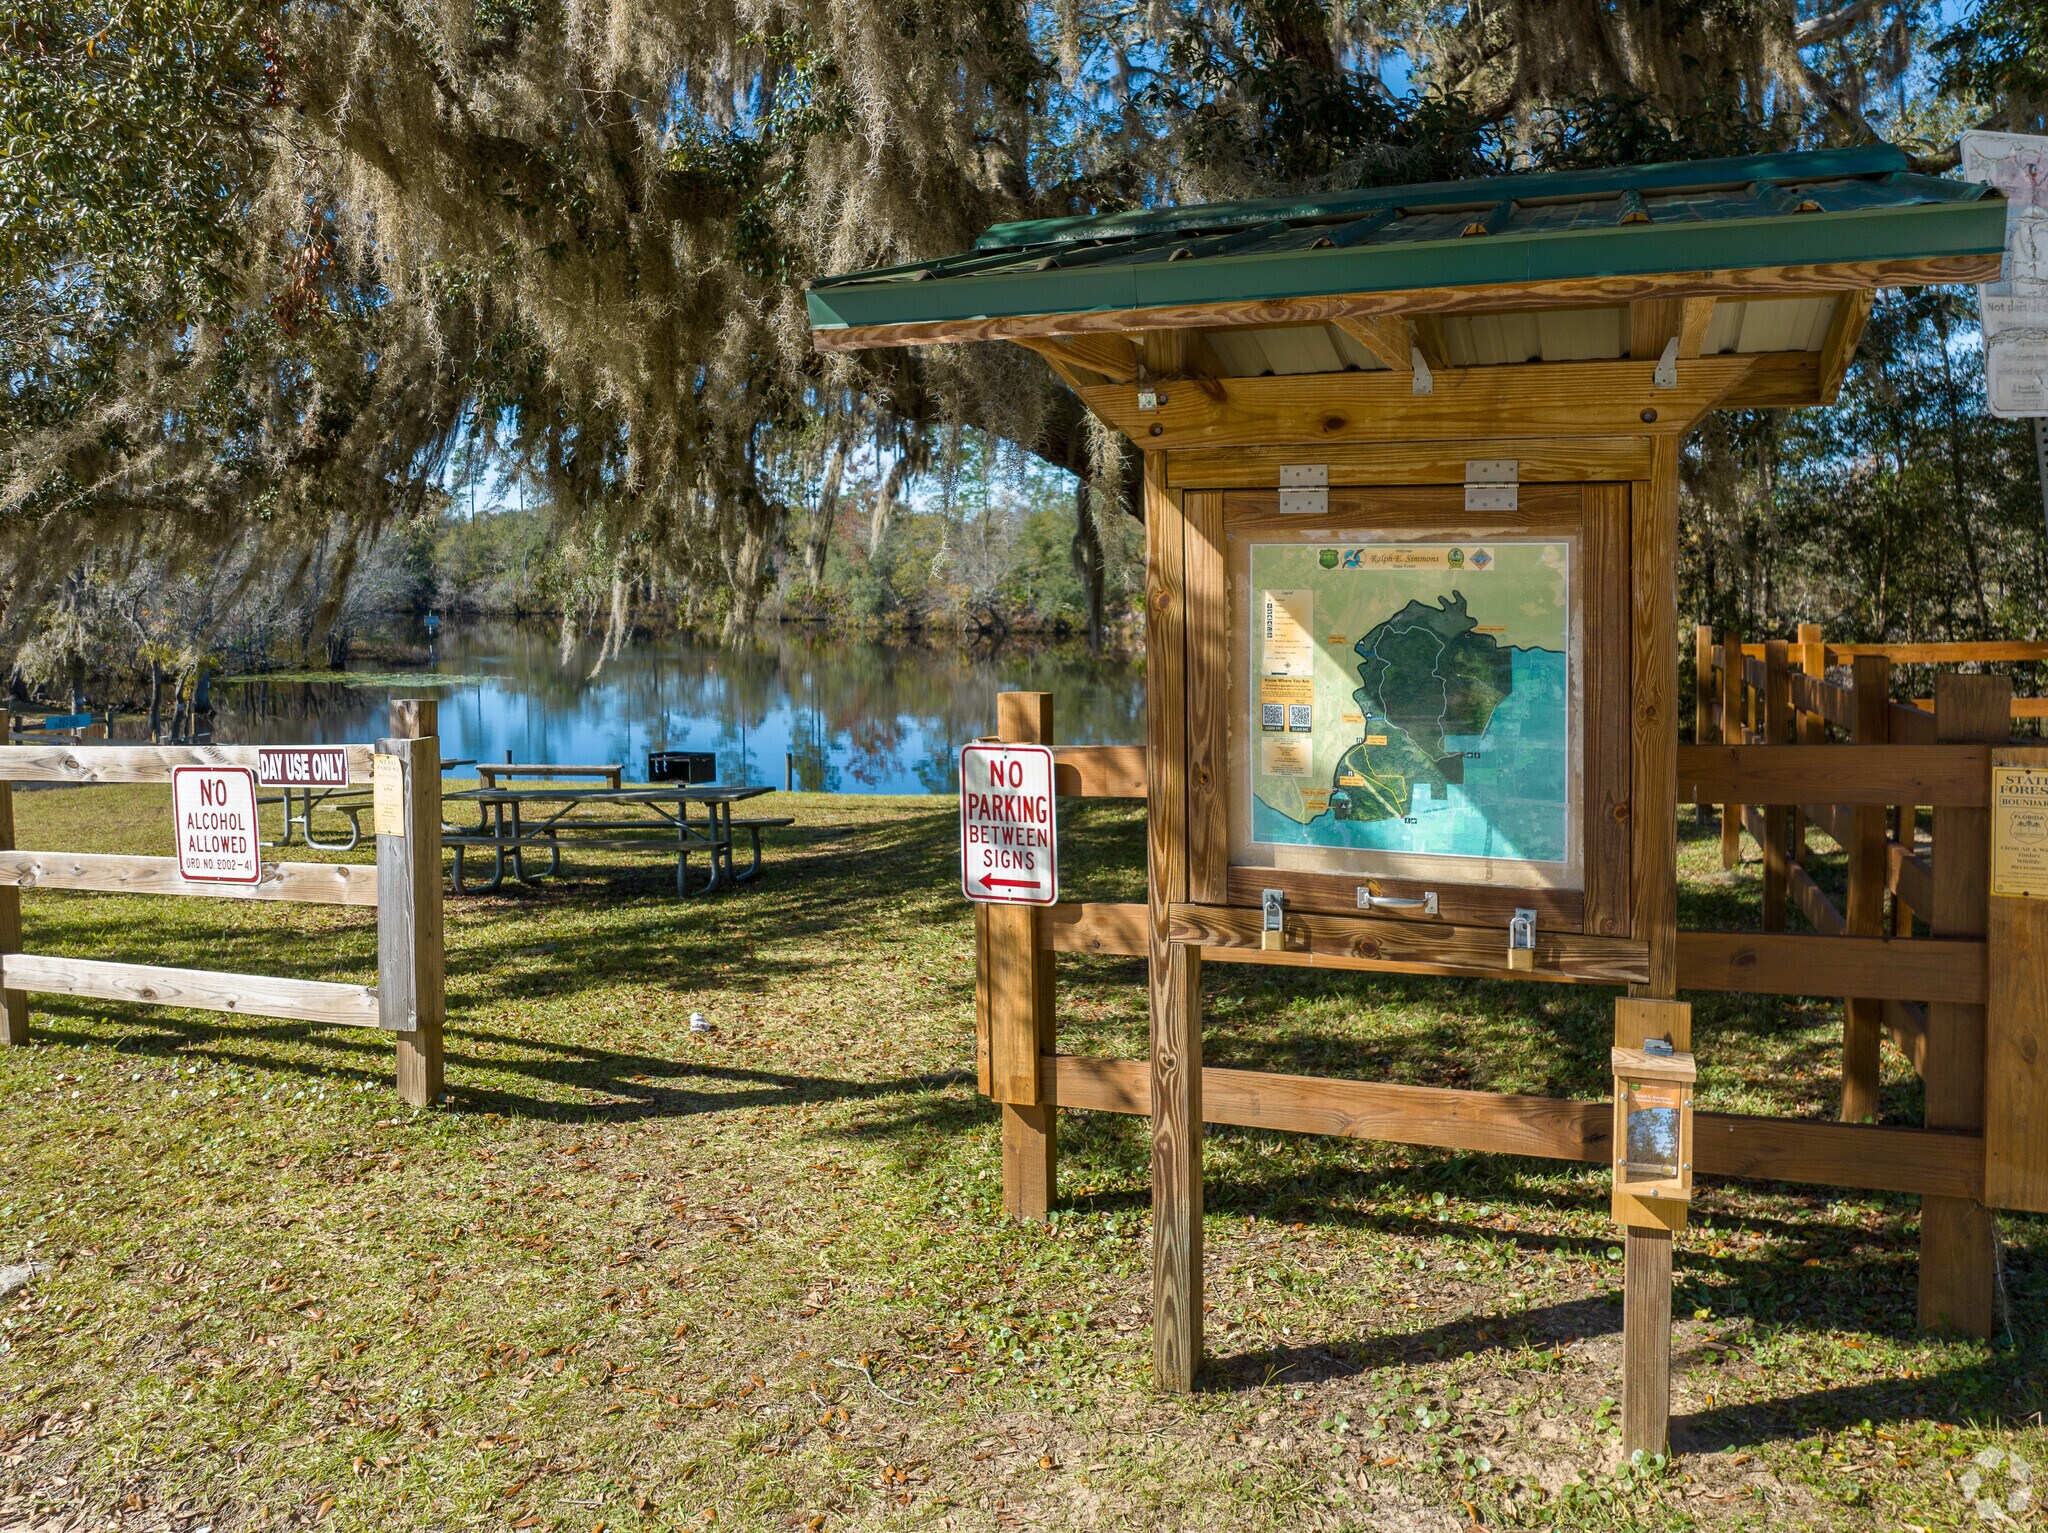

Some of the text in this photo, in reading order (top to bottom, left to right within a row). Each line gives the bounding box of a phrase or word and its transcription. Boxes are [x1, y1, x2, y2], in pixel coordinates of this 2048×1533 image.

[1988, 303, 2005, 311] Not
[2008, 303, 2027, 314] part
[1371, 554, 1440, 564] Ralph E. Simmons
[259, 753, 344, 781] DAY USE ONLY
[990, 760, 1023, 788] NO
[200, 779, 227, 806] NO
[2001, 785, 2048, 795] FORES
[968, 793, 1047, 824] PARKING
[2002, 798, 2048, 807] BOUNDAR
[187, 812, 246, 831] ALCOHOL
[189, 835, 247, 854] ALLOWED
[969, 825, 1048, 848] BETWEEN
[186, 858, 202, 869] ORD.
[203, 859, 216, 870] NO.
[983, 849, 1035, 871] SIGNS
